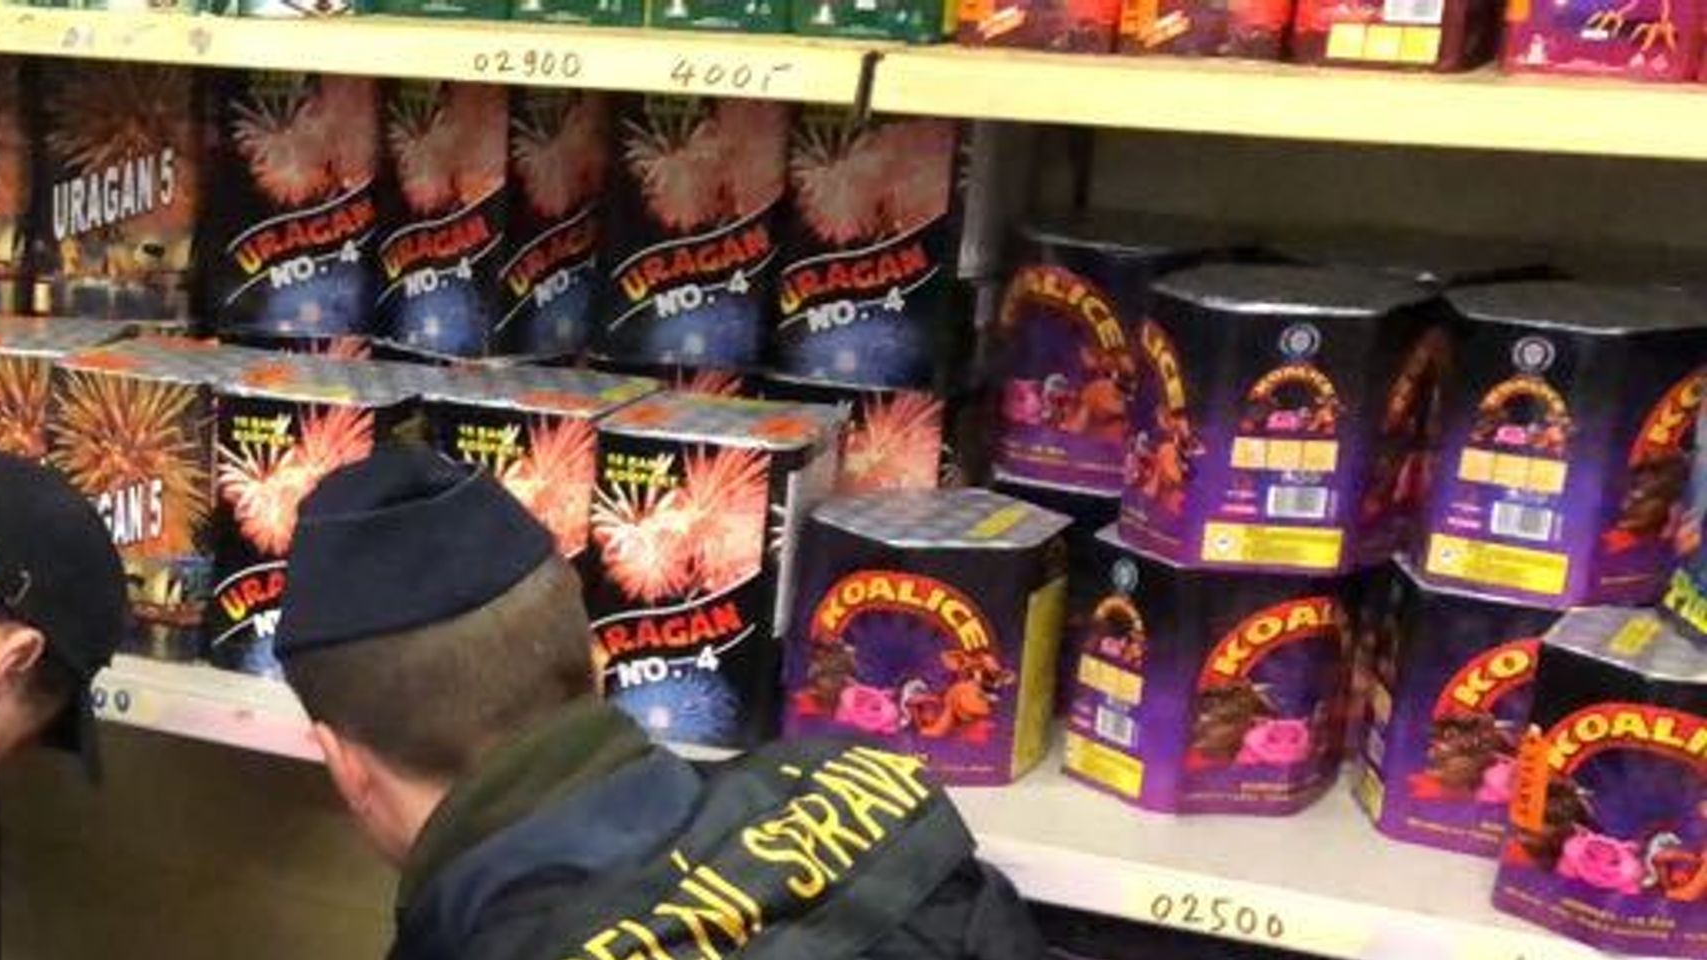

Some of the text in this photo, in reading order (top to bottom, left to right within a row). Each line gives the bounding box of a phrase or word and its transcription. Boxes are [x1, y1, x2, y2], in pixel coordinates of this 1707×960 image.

[474, 50, 582, 78] 02900
[53, 148, 175, 240] URAGAN 5
[235, 199, 375, 275] URAGAN
[383, 215, 491, 279] URAGAN
[508, 222, 594, 296] URAG
[620, 225, 770, 301] URAGAN
[729, 270, 749, 294] 4
[781, 244, 929, 314] URAGAN
[884, 287, 905, 311] 4
[97, 479, 163, 545] GAN 5
[221, 569, 285, 620] URA
[823, 579, 989, 651] KOALICE
[617, 645, 719, 688] NO. 4
[94, 687, 131, 712] 00
[1547, 712, 1707, 769] KOALI
[1150, 893, 1287, 939] 02500
